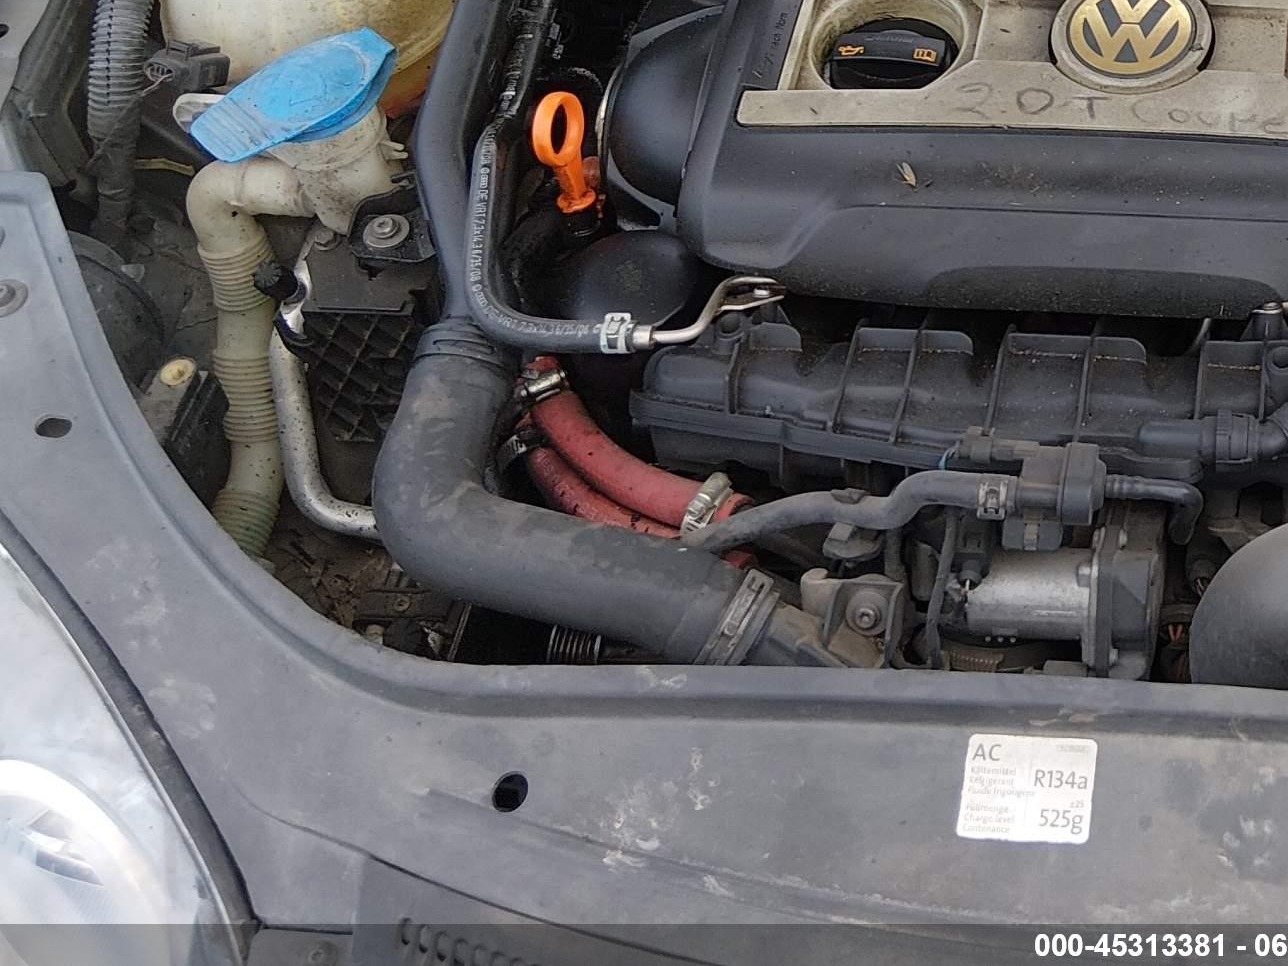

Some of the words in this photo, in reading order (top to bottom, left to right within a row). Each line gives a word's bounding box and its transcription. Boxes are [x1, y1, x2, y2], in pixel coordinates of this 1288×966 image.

[972, 743, 1002, 762] AC
[1033, 769, 1088, 790] R134a
[1038, 808, 1084, 835] 525g
